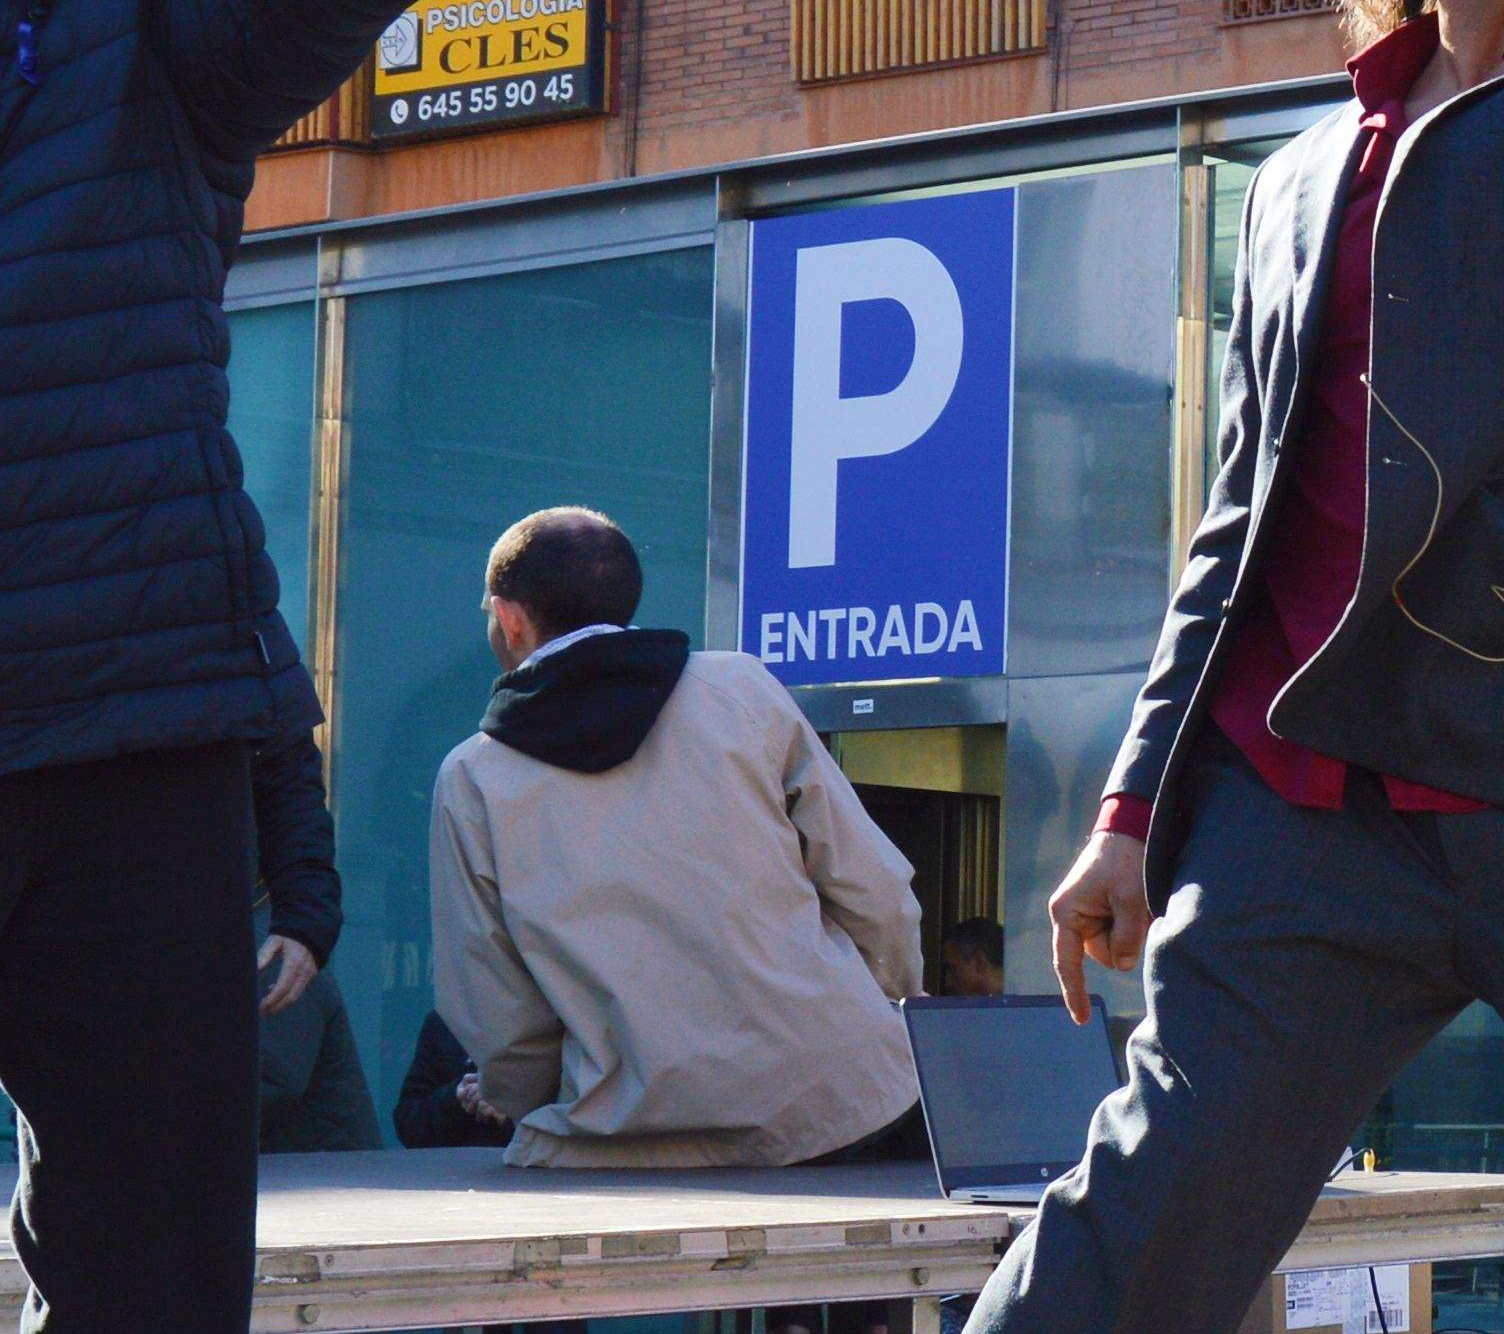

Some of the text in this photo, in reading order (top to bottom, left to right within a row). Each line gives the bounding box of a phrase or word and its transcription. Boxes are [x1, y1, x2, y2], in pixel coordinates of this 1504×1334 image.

[439, 21, 569, 74] CLES
[418, 74, 574, 121] 645 55 90 45
[788, 237, 964, 569] P
[760, 599, 984, 664] ENTRADA
